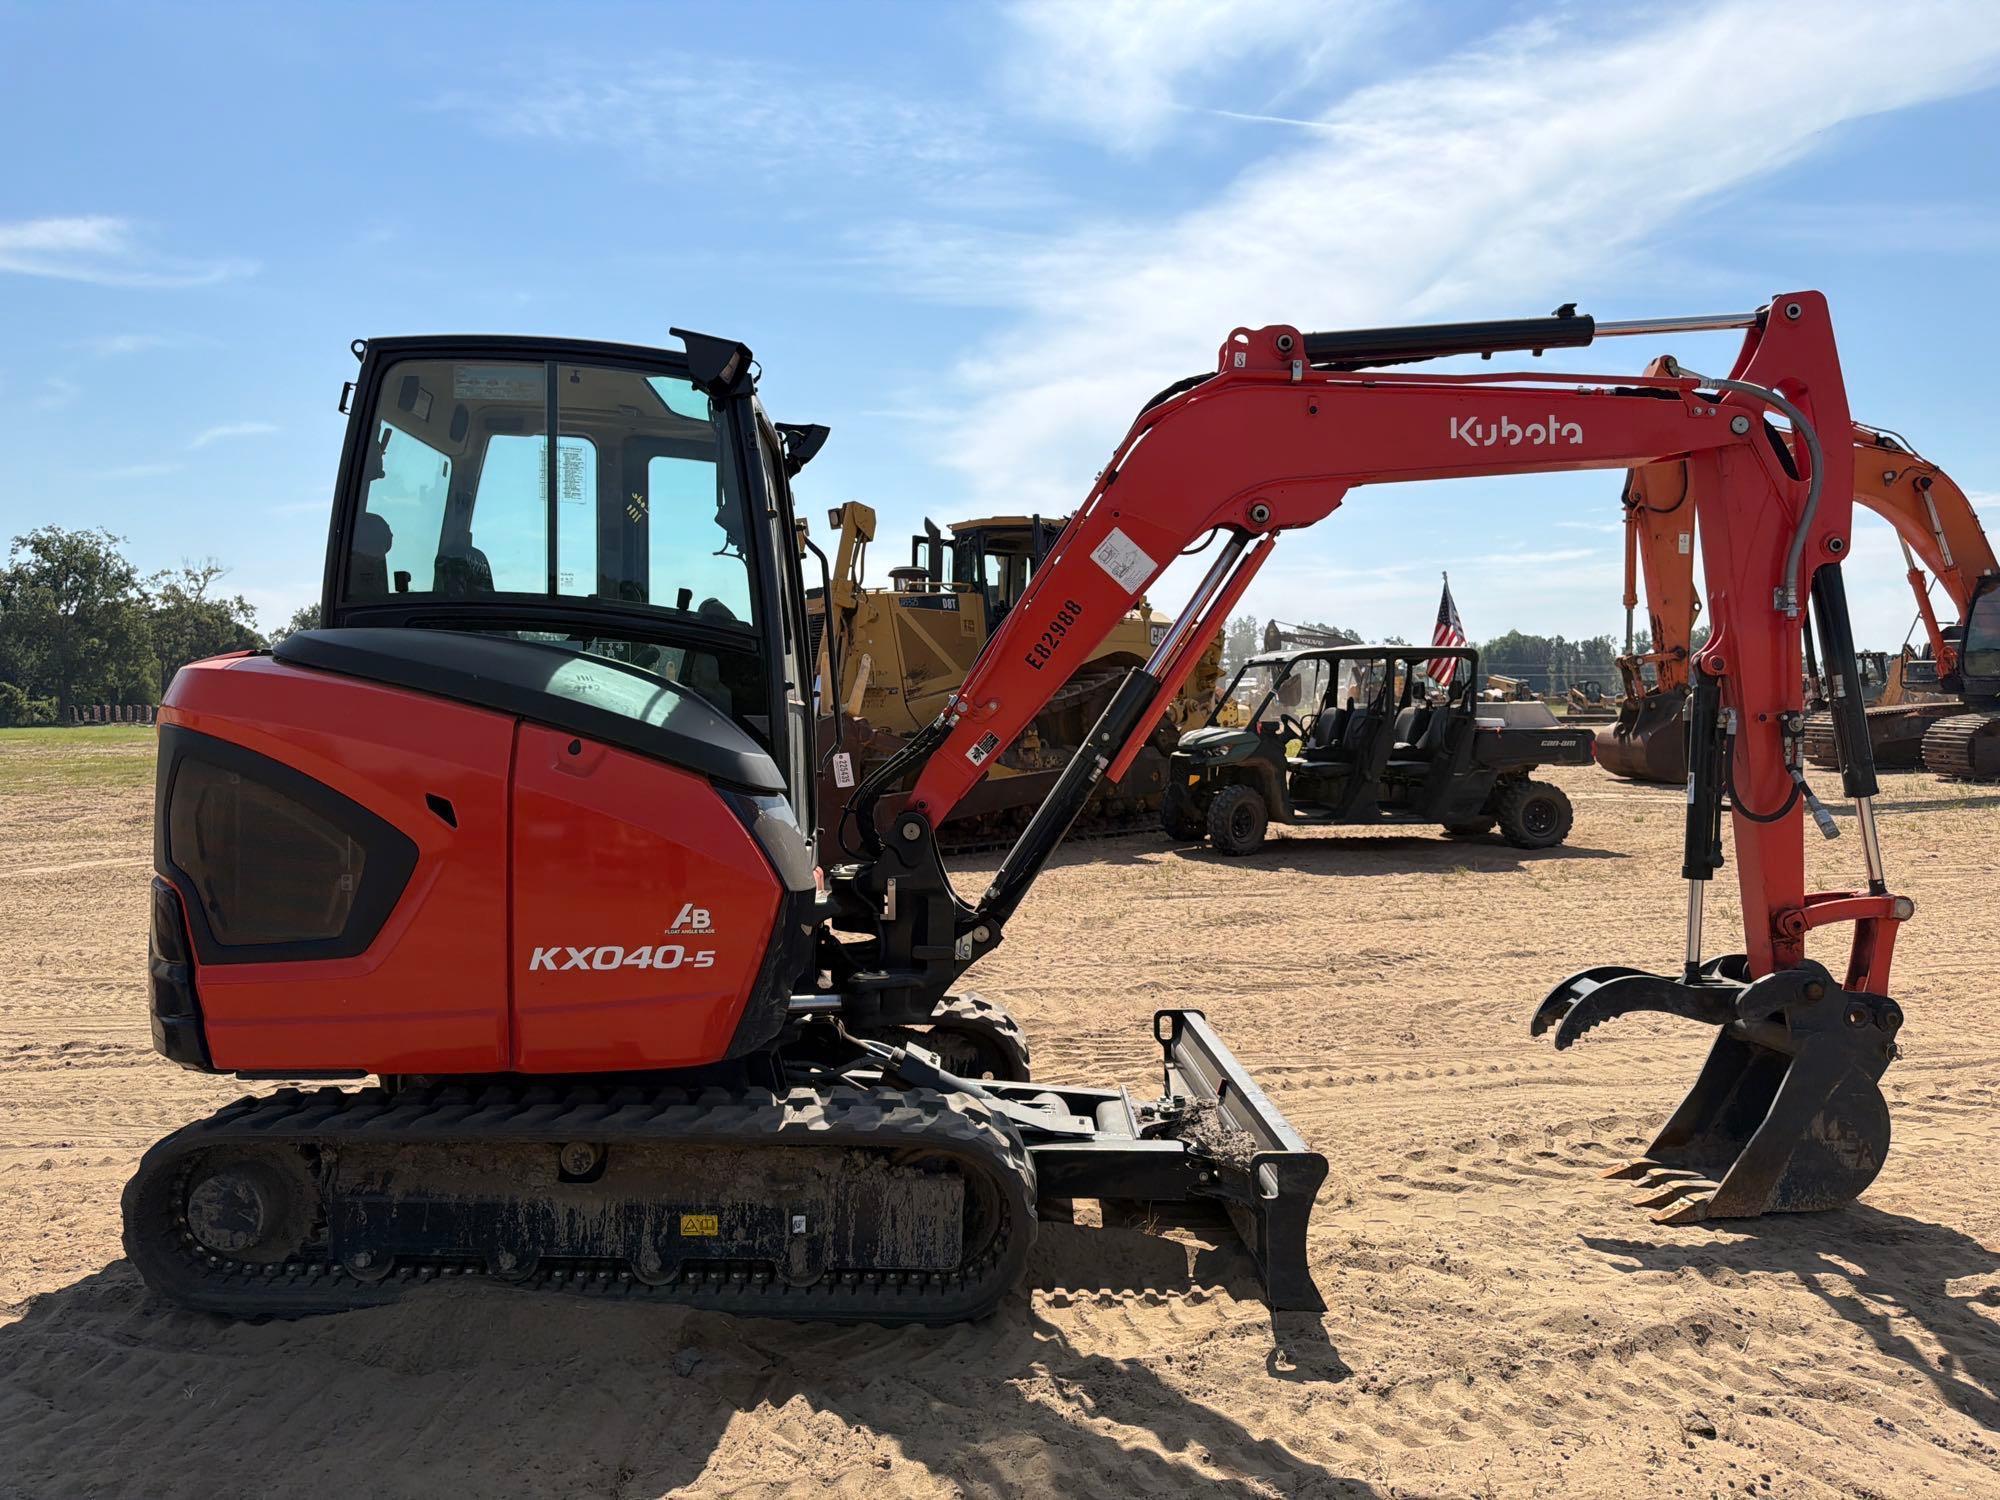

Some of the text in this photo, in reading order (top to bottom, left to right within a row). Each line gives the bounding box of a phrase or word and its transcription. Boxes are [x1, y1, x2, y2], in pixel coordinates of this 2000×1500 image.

[1450, 414, 1583, 447] Kubota
[942, 598, 956, 609] D8T
[1024, 599, 1082, 671] E82988
[1295, 636, 1325, 646] VOLVO
[839, 759, 850, 783] 225435
[529, 945, 716, 970] KX040-5
